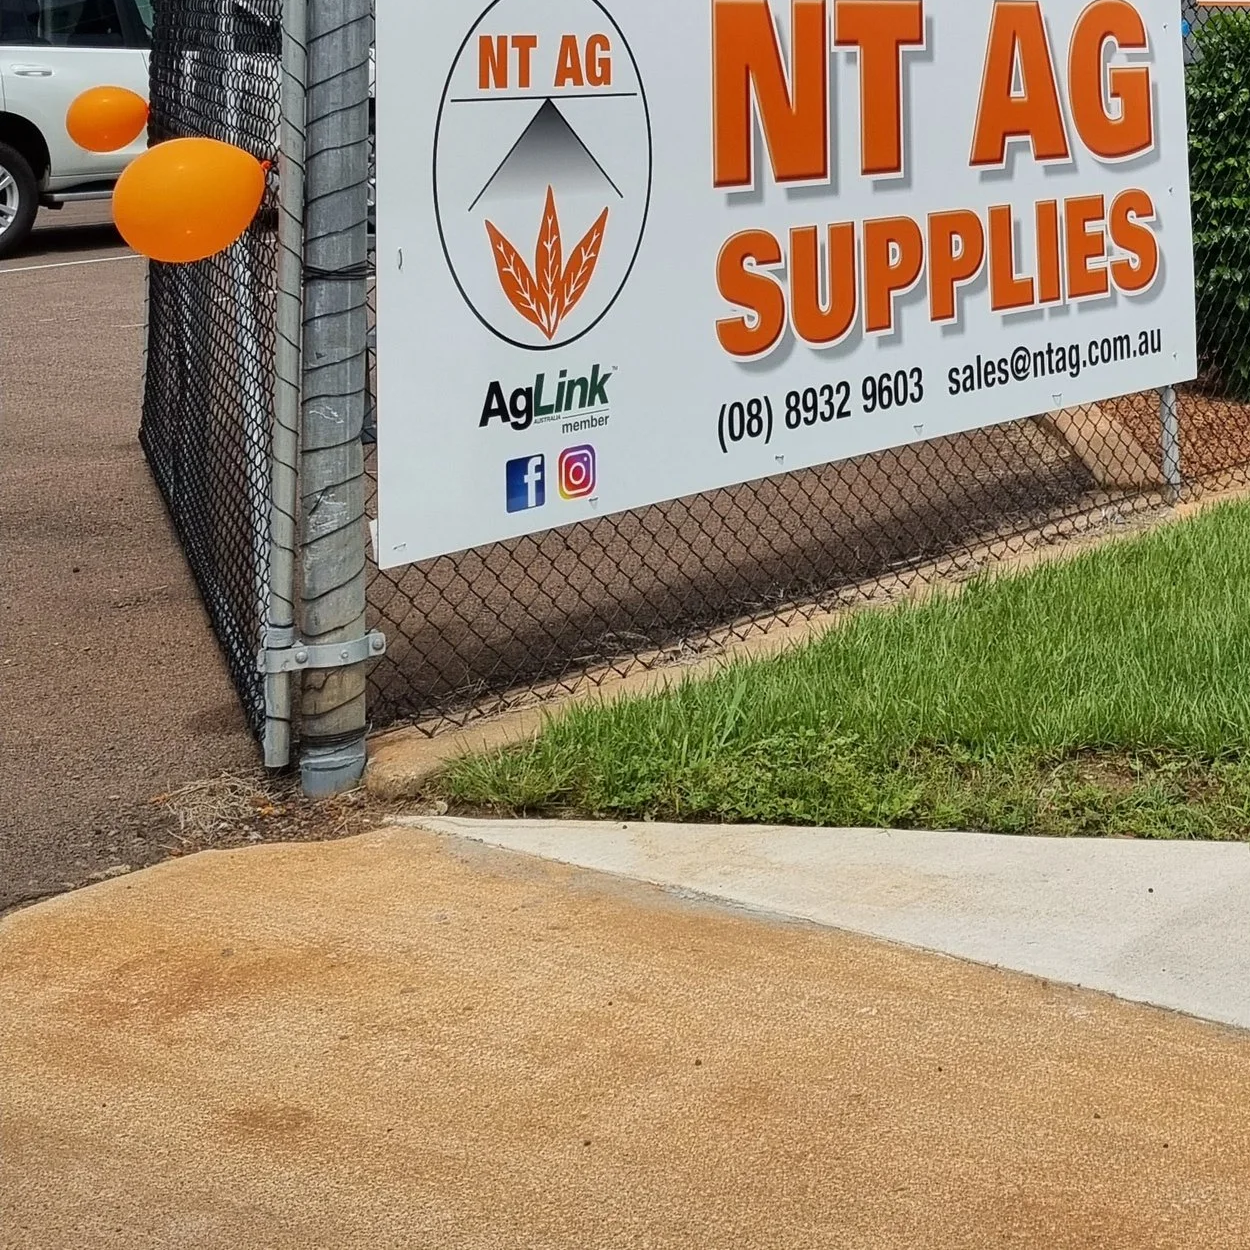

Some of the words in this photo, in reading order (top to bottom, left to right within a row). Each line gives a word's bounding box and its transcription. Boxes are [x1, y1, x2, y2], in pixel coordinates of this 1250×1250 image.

[478, 35, 537, 89] NT
[554, 34, 612, 87] AG
[715, 189, 1159, 358] SUPPLIES
[478, 363, 613, 431] AgLink
[561, 415, 610, 434] member
[717, 393, 774, 453] (08)
[784, 380, 852, 430] 8932
[862, 367, 924, 413] 9603
[948, 328, 1164, 395] sales@ntag.com.au
